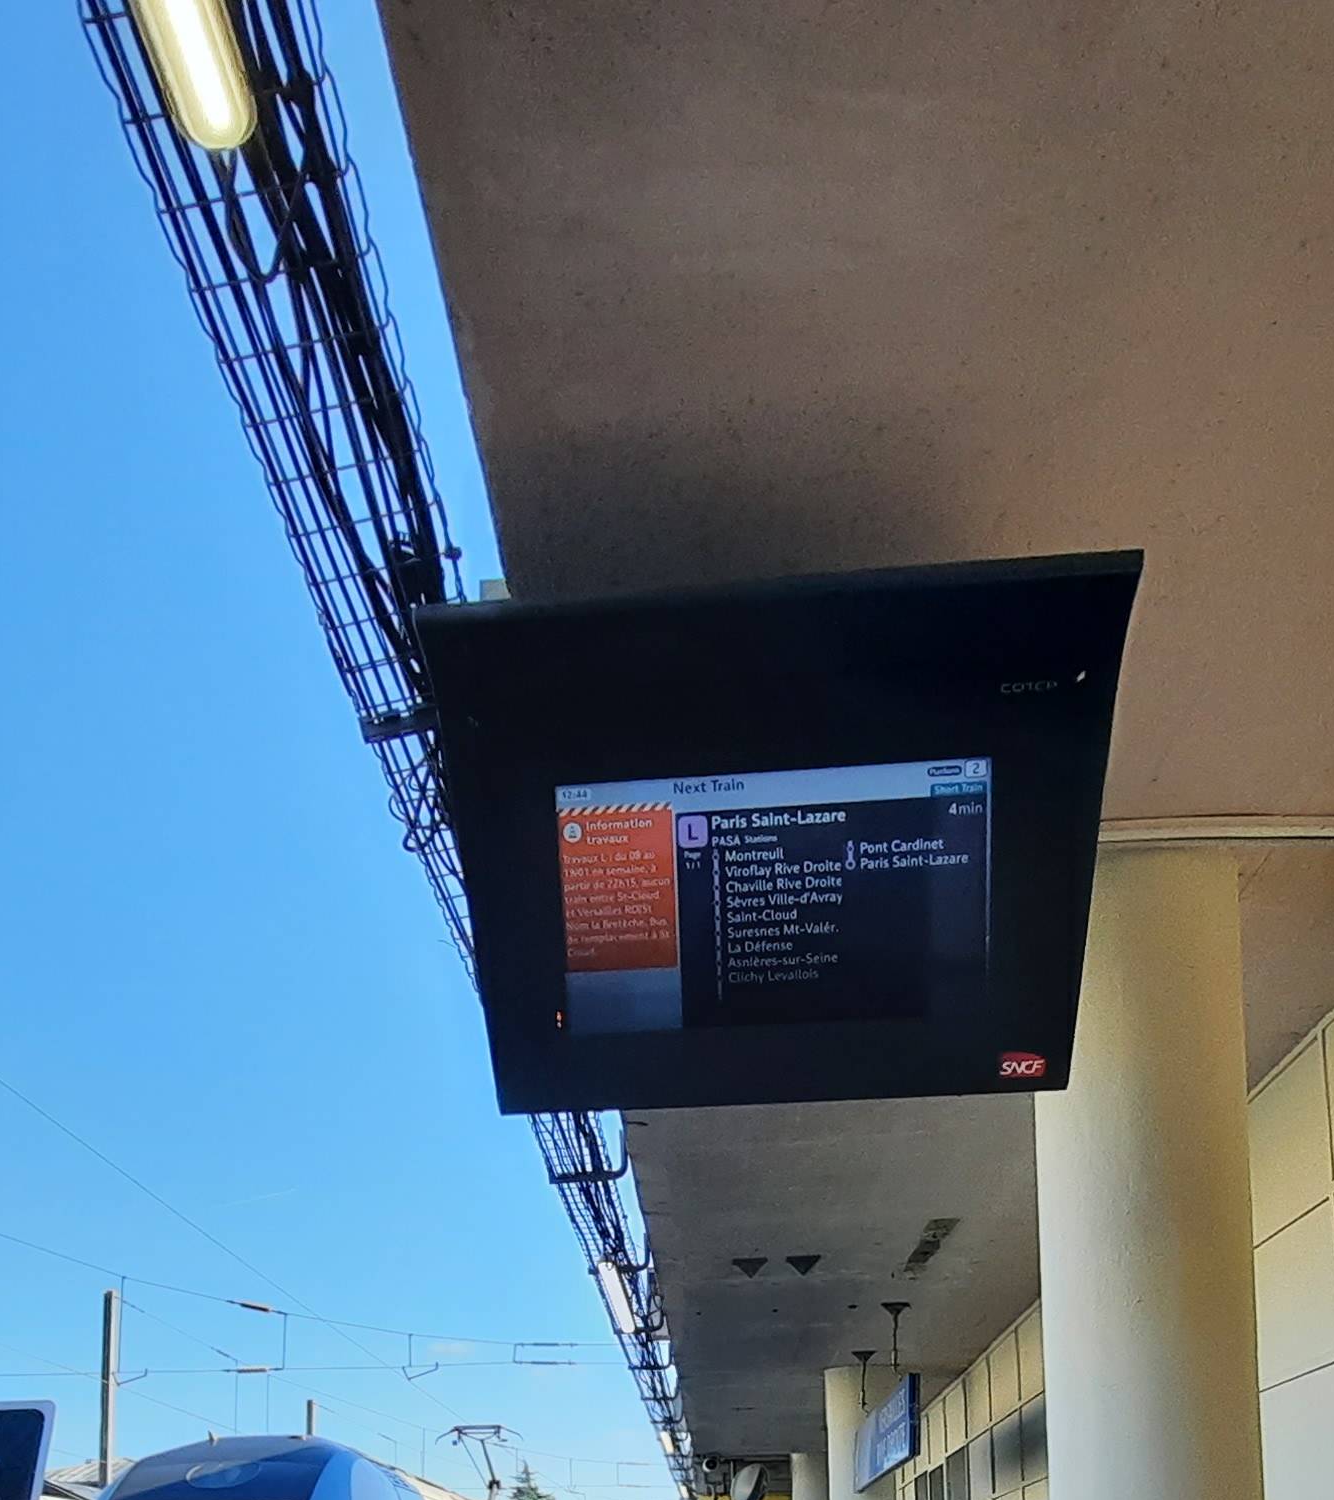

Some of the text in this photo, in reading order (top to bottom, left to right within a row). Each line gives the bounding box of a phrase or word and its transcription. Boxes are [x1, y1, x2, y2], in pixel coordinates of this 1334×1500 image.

[972, 763, 981, 774] 2
[673, 778, 745, 795] Next Train
[934, 782, 983, 795] Short Train
[586, 819, 653, 832] Information
[711, 810, 847, 830] Paris Saint-Lazare
[687, 823, 699, 841] L
[587, 835, 629, 845] travaux
[711, 836, 741, 847] PASA
[860, 838, 945, 854] Pont Cardinet
[725, 848, 785, 862] Montreuil
[860, 854, 969, 870] Paris Saint-Lazare
[725, 860, 842, 879] Viroflay Rive Droite
[725, 876, 843, 893] Chaville Rive Droite
[768, 891, 844, 905] Ville-d'Avray
[727, 909, 798, 923] Saint-Cloud
[727, 926, 780, 939] Suresnes
[727, 941, 794, 954] La Défense
[727, 952, 839, 968] Asnières-sur-Seine
[728, 968, 819, 984] Clichy Levallois
[1000, 1060, 1044, 1075] SNCF
